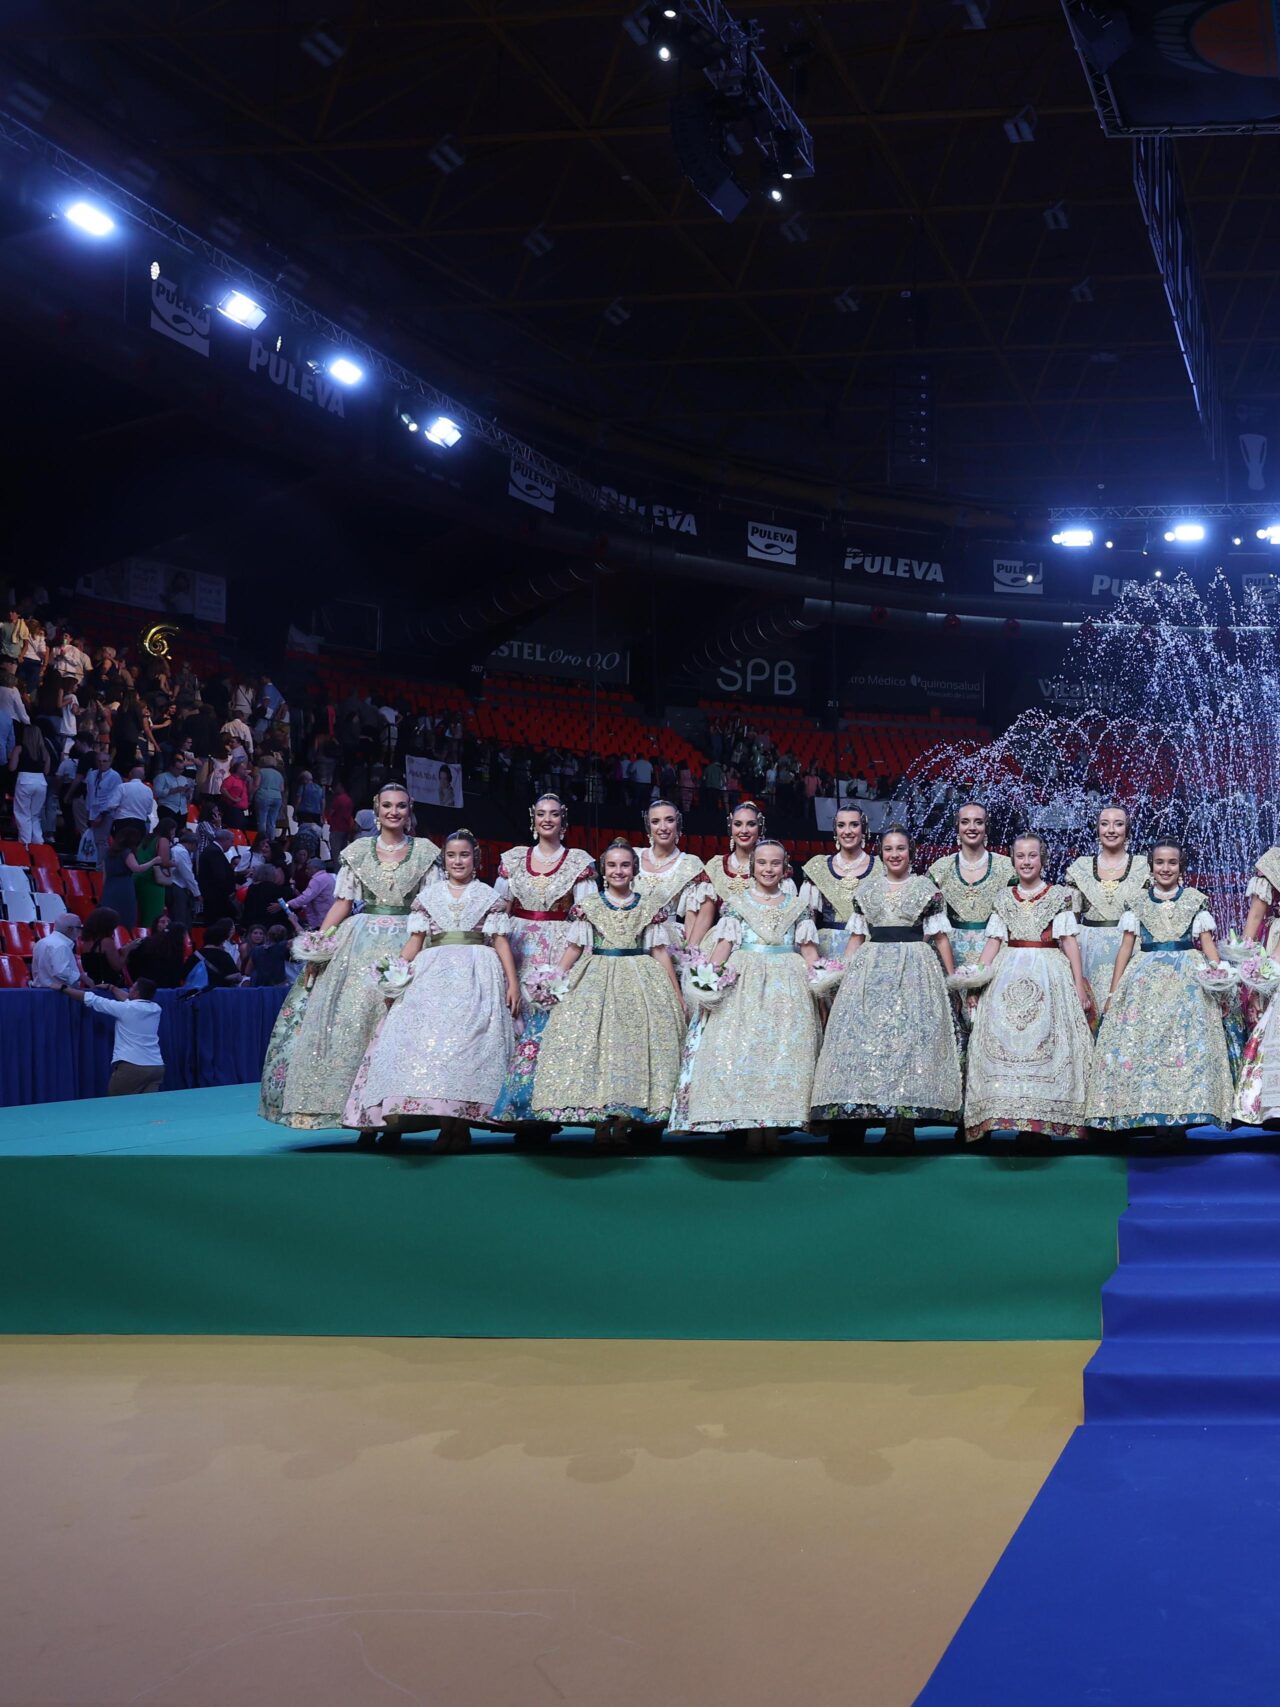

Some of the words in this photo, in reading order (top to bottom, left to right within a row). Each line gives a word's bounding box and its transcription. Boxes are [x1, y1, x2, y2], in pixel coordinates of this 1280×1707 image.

[156, 282, 207, 323] PULEVA
[249, 336, 345, 418] PULEVA
[513, 462, 553, 488] PULEVA
[752, 527, 795, 545] PULEVA
[843, 547, 944, 583] PULEVA
[491, 640, 546, 661] STEL
[549, 649, 581, 667] Oro
[716, 657, 797, 695] SPB
